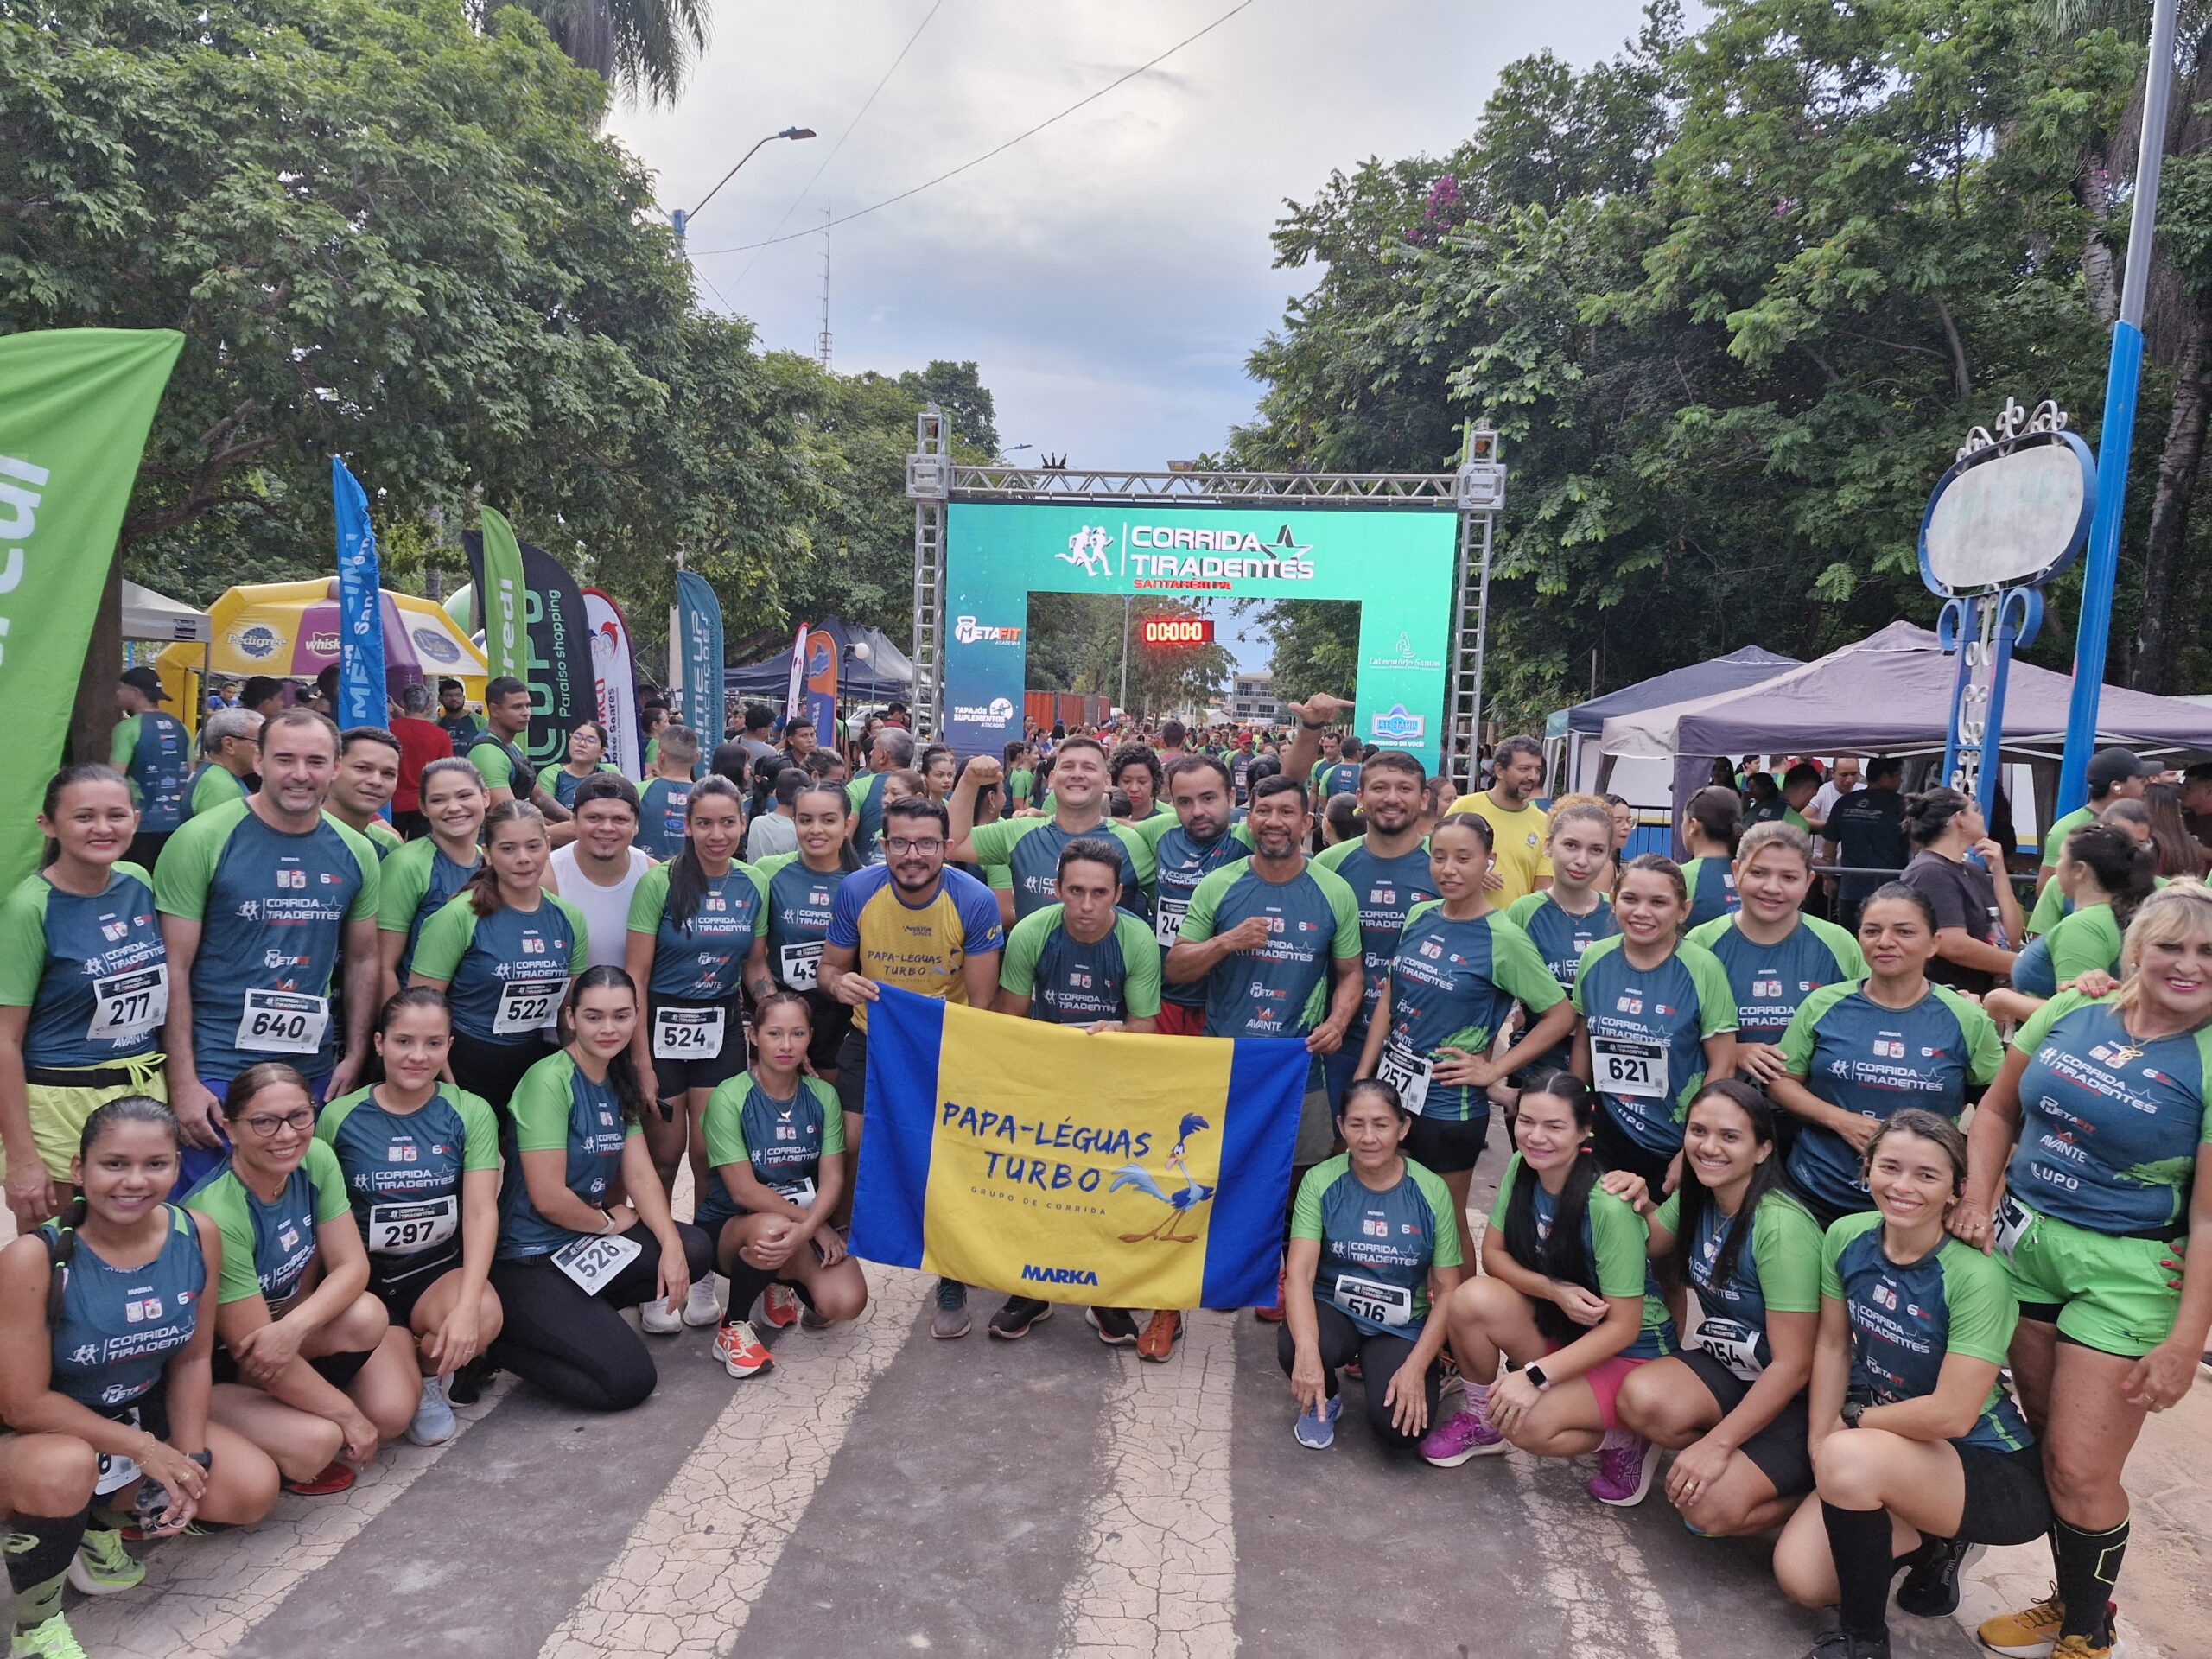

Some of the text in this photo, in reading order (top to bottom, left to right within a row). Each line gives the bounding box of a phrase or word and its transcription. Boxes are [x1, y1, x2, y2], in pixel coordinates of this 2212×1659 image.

[1131, 525, 1262, 551] CORRIDA
[1130, 553, 1315, 580] TIRADENTES
[226, 633, 288, 648] Pedigree
[305, 636, 342, 652] whisk
[548, 589, 572, 718] Paraíso shopping
[1369, 657, 1441, 667] Laboratório Santos
[953, 706, 988, 715] TAPAJÓS
[953, 714, 1006, 723] SUPLEMENTOS
[607, 688, 619, 766] José Soares
[266, 898, 321, 909] CORRIDA
[798, 909, 832, 918] CORRID
[266, 910, 342, 921] TIRADENTES
[798, 918, 830, 926] TIRADE
[1358, 910, 1406, 919] CORRIDA
[1358, 919, 1404, 929] TIRADEN
[1161, 915, 1180, 935] 24
[105, 940, 149, 961] CORRIDA
[1250, 947, 1314, 962] TIRADENTES
[1262, 940, 1294, 950] RRIDA
[110, 944, 166, 973] TIRADENTE
[516, 960, 558, 969] CORRIDA
[867, 950, 943, 964] PAPA-LÉGUAS
[1403, 957, 1439, 975] CORRIDA
[516, 969, 569, 979] TIRADENTE
[792, 959, 818, 980] 43
[884, 965, 927, 976] TURBO
[1402, 966, 1454, 992] TIRADENTES
[1058, 992, 1100, 1002] CORRIDA
[1058, 1001, 1117, 1013] TIRADENTES
[109, 992, 150, 1027] 277
[507, 998, 549, 1020] 522
[1738, 1005, 1796, 1015] CORRIDA
[251, 1012, 307, 1039] 640
[1245, 1018, 1283, 1032] AVANTE
[1600, 1016, 1649, 1033] CORRIDA
[1738, 1016, 1792, 1026] TIRADE
[664, 1027, 707, 1047] 524
[1599, 1026, 1672, 1047] TIRADENTES
[1382, 1064, 1413, 1094] 257
[1608, 1057, 1649, 1083] 621
[1855, 1061, 1918, 1078] CORRIDA
[2062, 1052, 2126, 1090] CORRIDA
[1855, 1071, 1945, 1092] TIRADENTES
[2053, 1061, 2158, 1115] TIRADENTES
[598, 1133, 622, 1142] CORRIDA
[942, 1099, 1153, 1160] PAPA-LÉGUAS
[766, 1146, 807, 1155] CORRIDA
[2039, 1134, 2088, 1164] AVANTE
[375, 1168, 432, 1180] CORRIDA
[983, 1151, 1102, 1193] TURBO
[2031, 1161, 2080, 1192] LUPO
[375, 1175, 456, 1190] TIRADENTES
[970, 1186, 1108, 1217] GRUPO DE CORRIDA
[384, 1220, 435, 1248] 297
[1351, 1242, 1399, 1255] CORRIDA
[575, 1241, 620, 1279] 526
[1350, 1252, 1419, 1267] TIRADENTES
[1020, 1263, 1099, 1287] MARKA
[1347, 1298, 1386, 1323] 516
[1859, 1304, 1904, 1335] CORRIDA
[108, 1325, 181, 1350] CORRIDA
[1859, 1316, 1930, 1355] TIRADENTES
[107, 1331, 194, 1362] TIRADENTE
